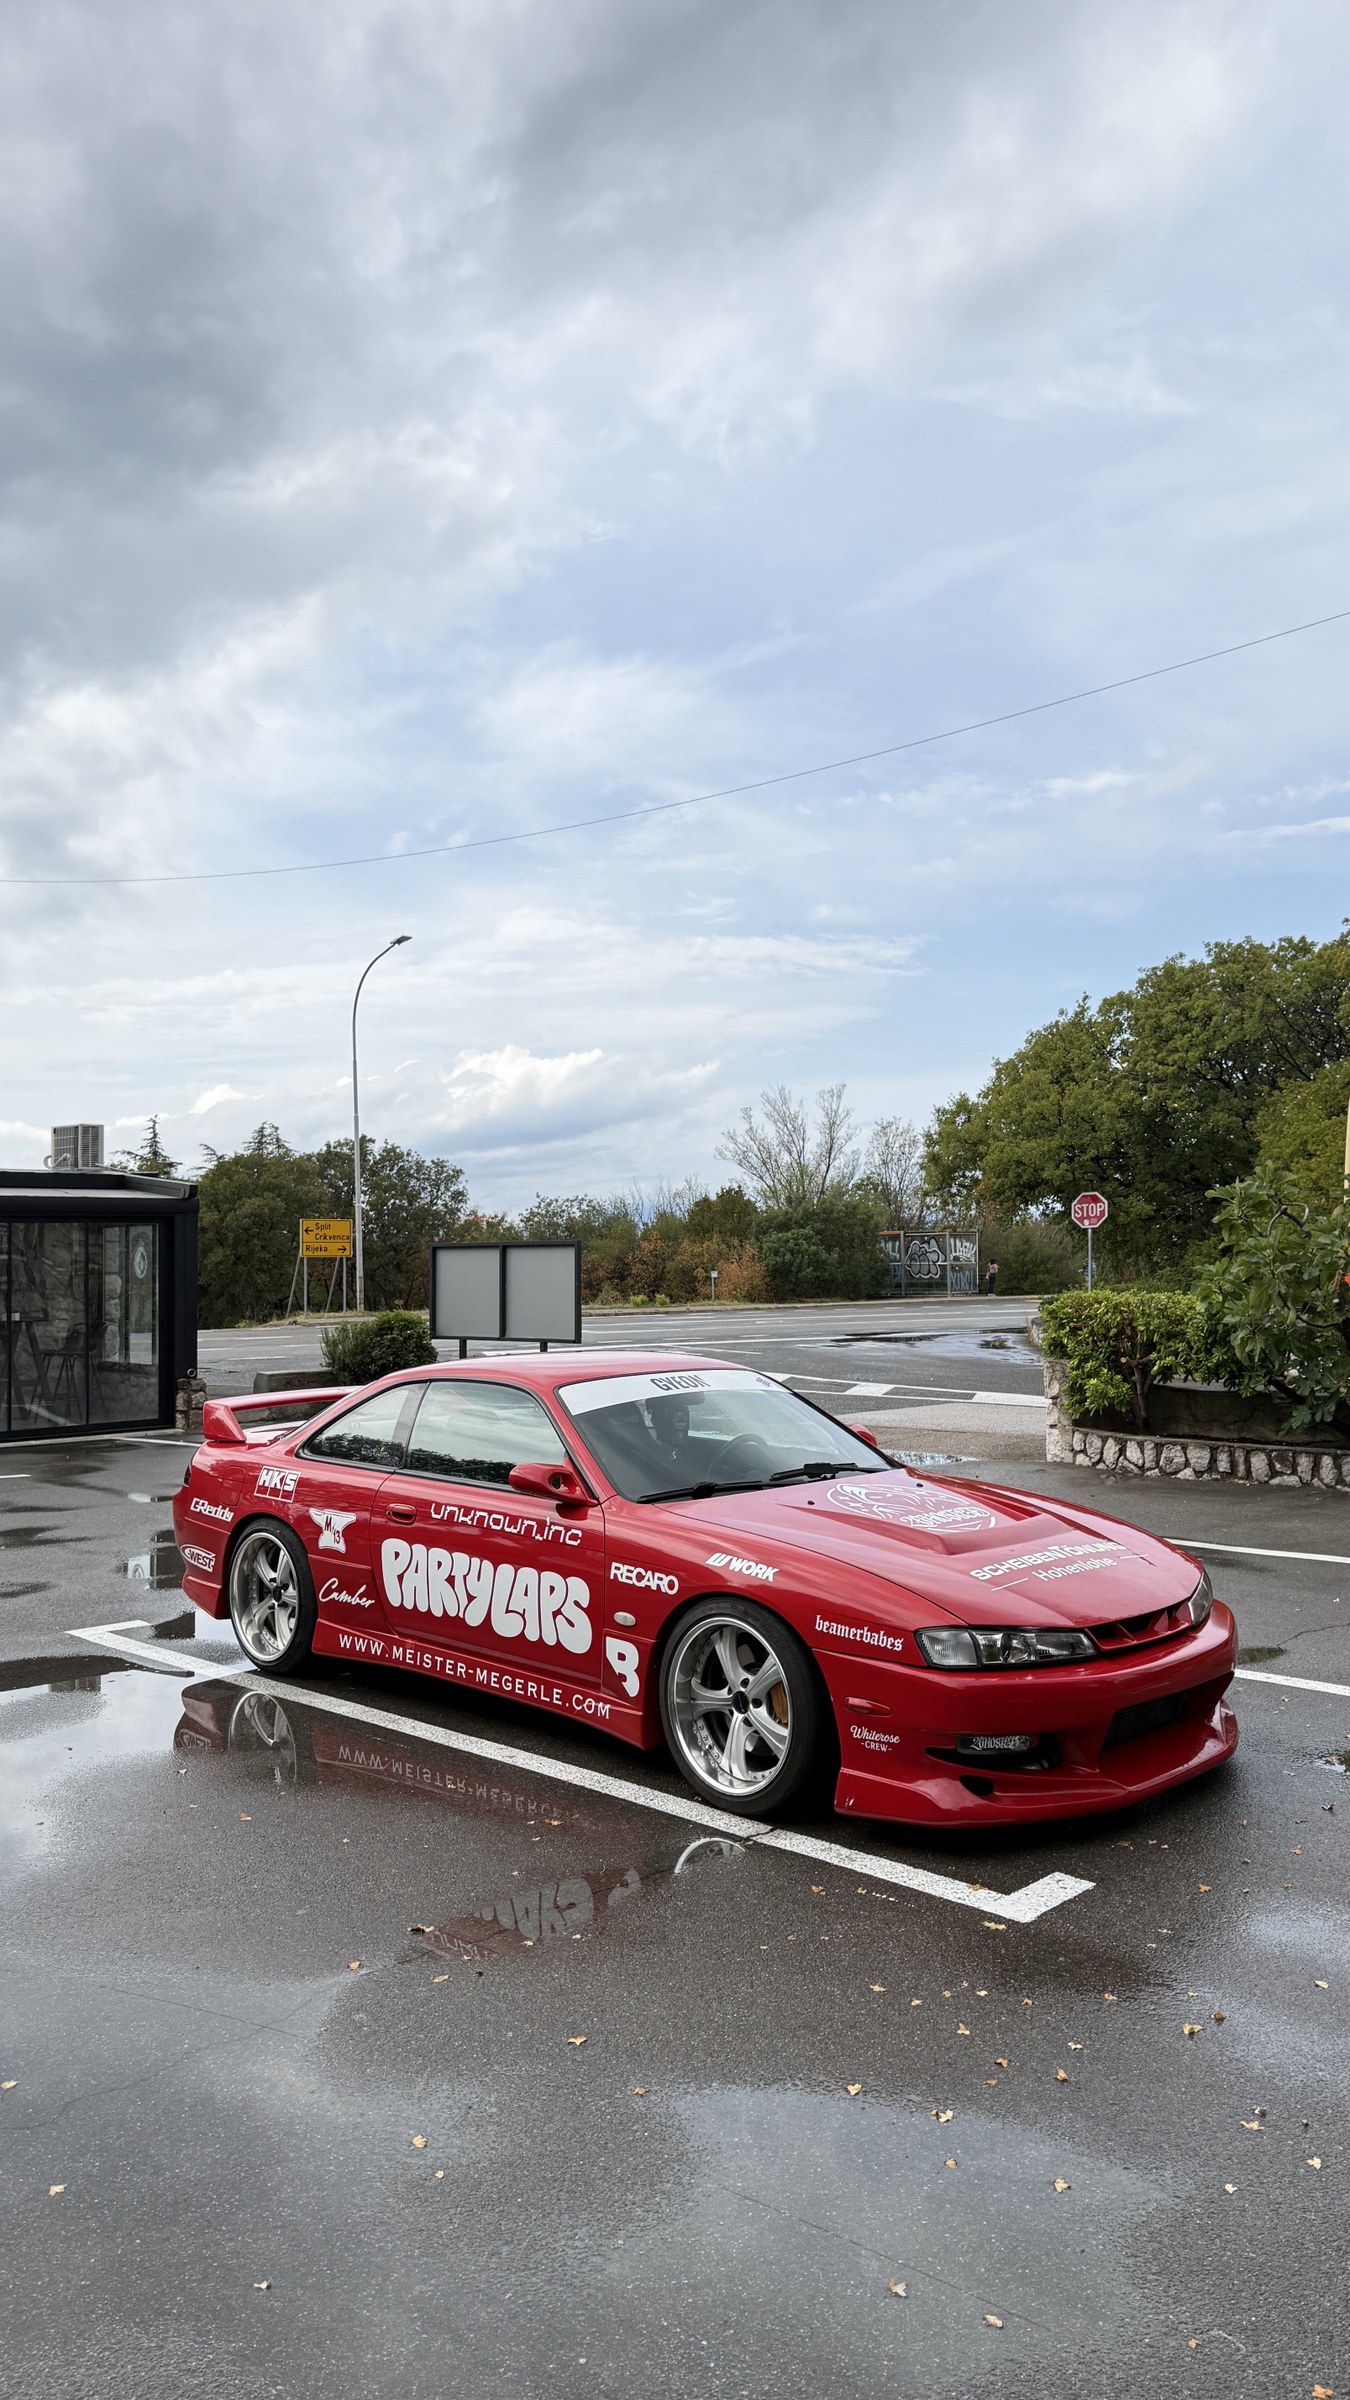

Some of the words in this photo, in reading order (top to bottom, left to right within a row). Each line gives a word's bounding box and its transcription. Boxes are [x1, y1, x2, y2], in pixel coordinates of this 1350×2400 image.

[1074, 1203, 1105, 1218] STOP
[314, 1233, 350, 1241] Crikvenica
[315, 1222, 331, 1231] Split
[305, 1245, 328, 1254] Rijeka
[650, 1375, 711, 1391] GYEON
[257, 1468, 298, 1493] HKS
[610, 1562, 679, 1595] RECARO
[1032, 1557, 1117, 1581] Hohenlohe
[319, 1578, 376, 1608] Camber
[815, 1615, 904, 1651] beamerbabes
[338, 1633, 611, 1720] WWW.MEISTER-MEGERLE.COM
